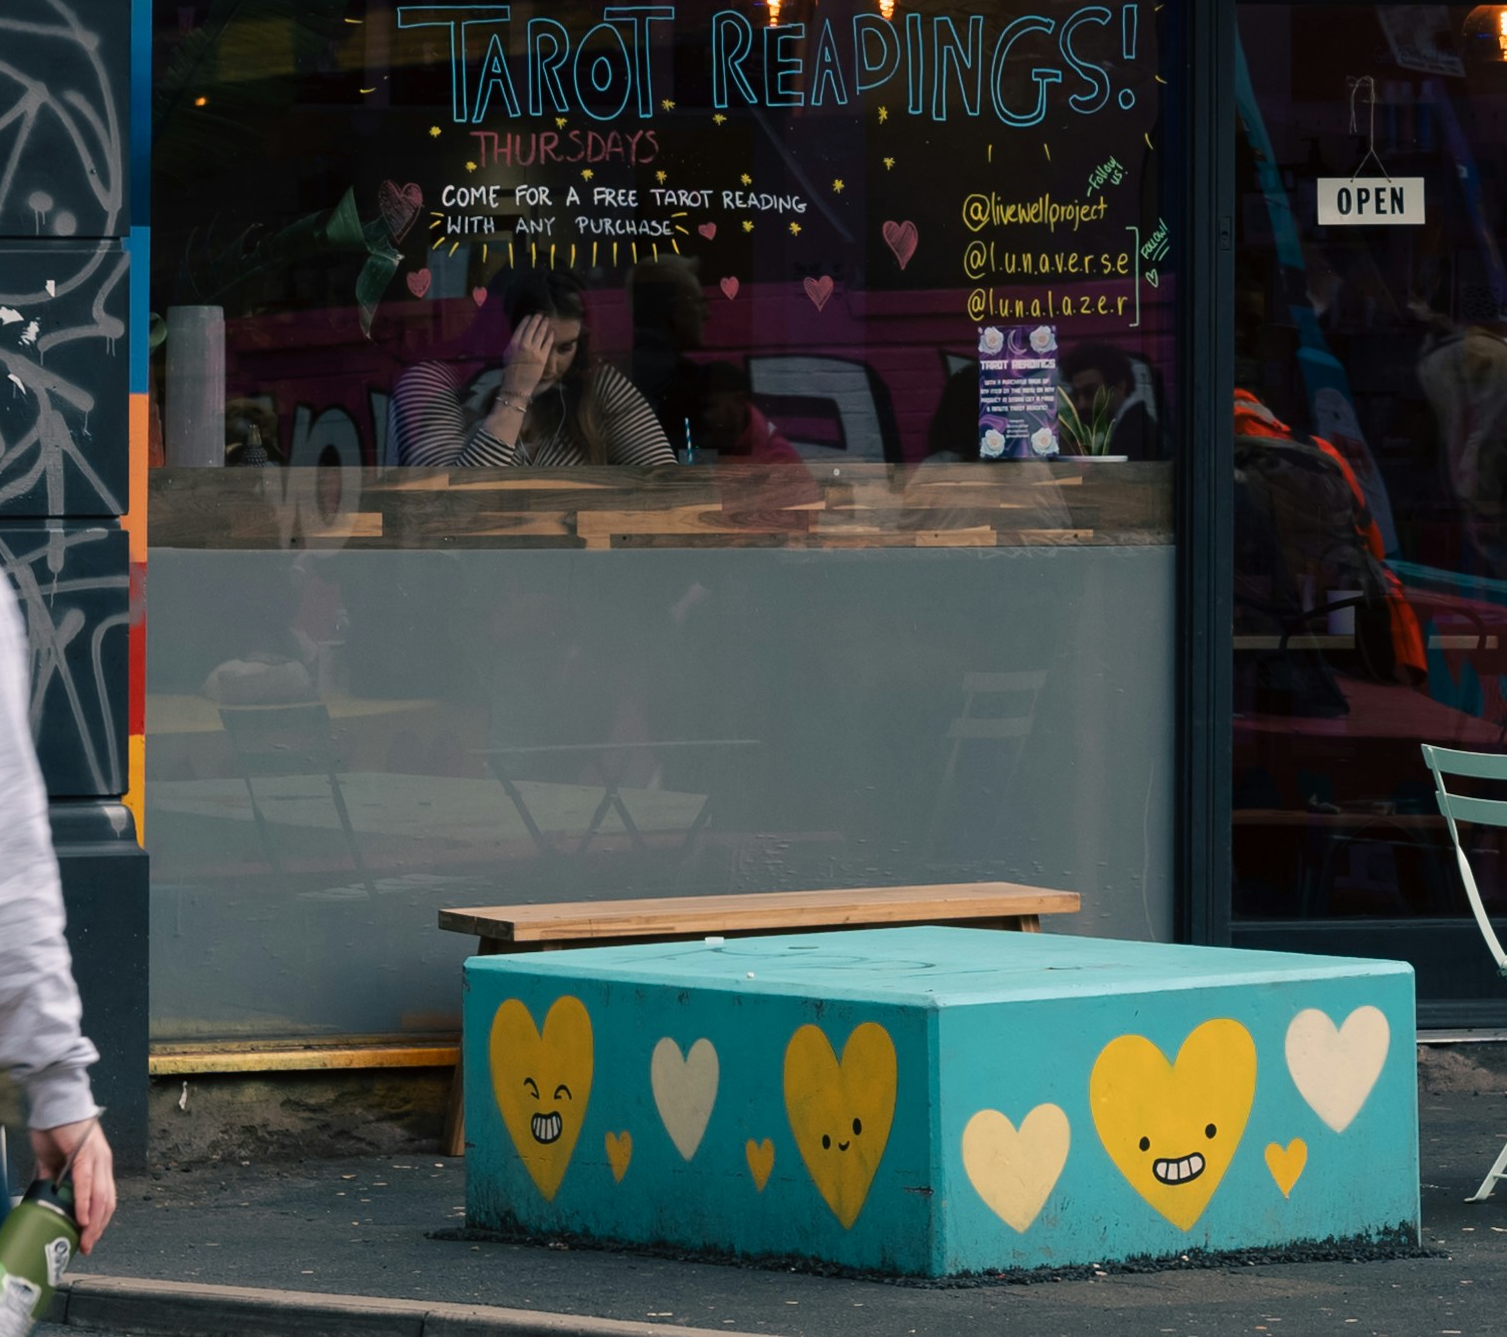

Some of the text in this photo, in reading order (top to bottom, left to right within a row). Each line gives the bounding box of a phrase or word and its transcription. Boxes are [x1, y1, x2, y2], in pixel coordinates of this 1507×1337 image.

[397, 4, 1139, 128] TAROT READINGS!
[469, 128, 660, 168] THURSDAYS
[441, 184, 808, 214] COME FOR A FREE TAROT READING
[962, 191, 1108, 233] @livewellproject
[1337, 186, 1405, 215] OPEN
[445, 215, 675, 237] WITH ANY PURCHASE
